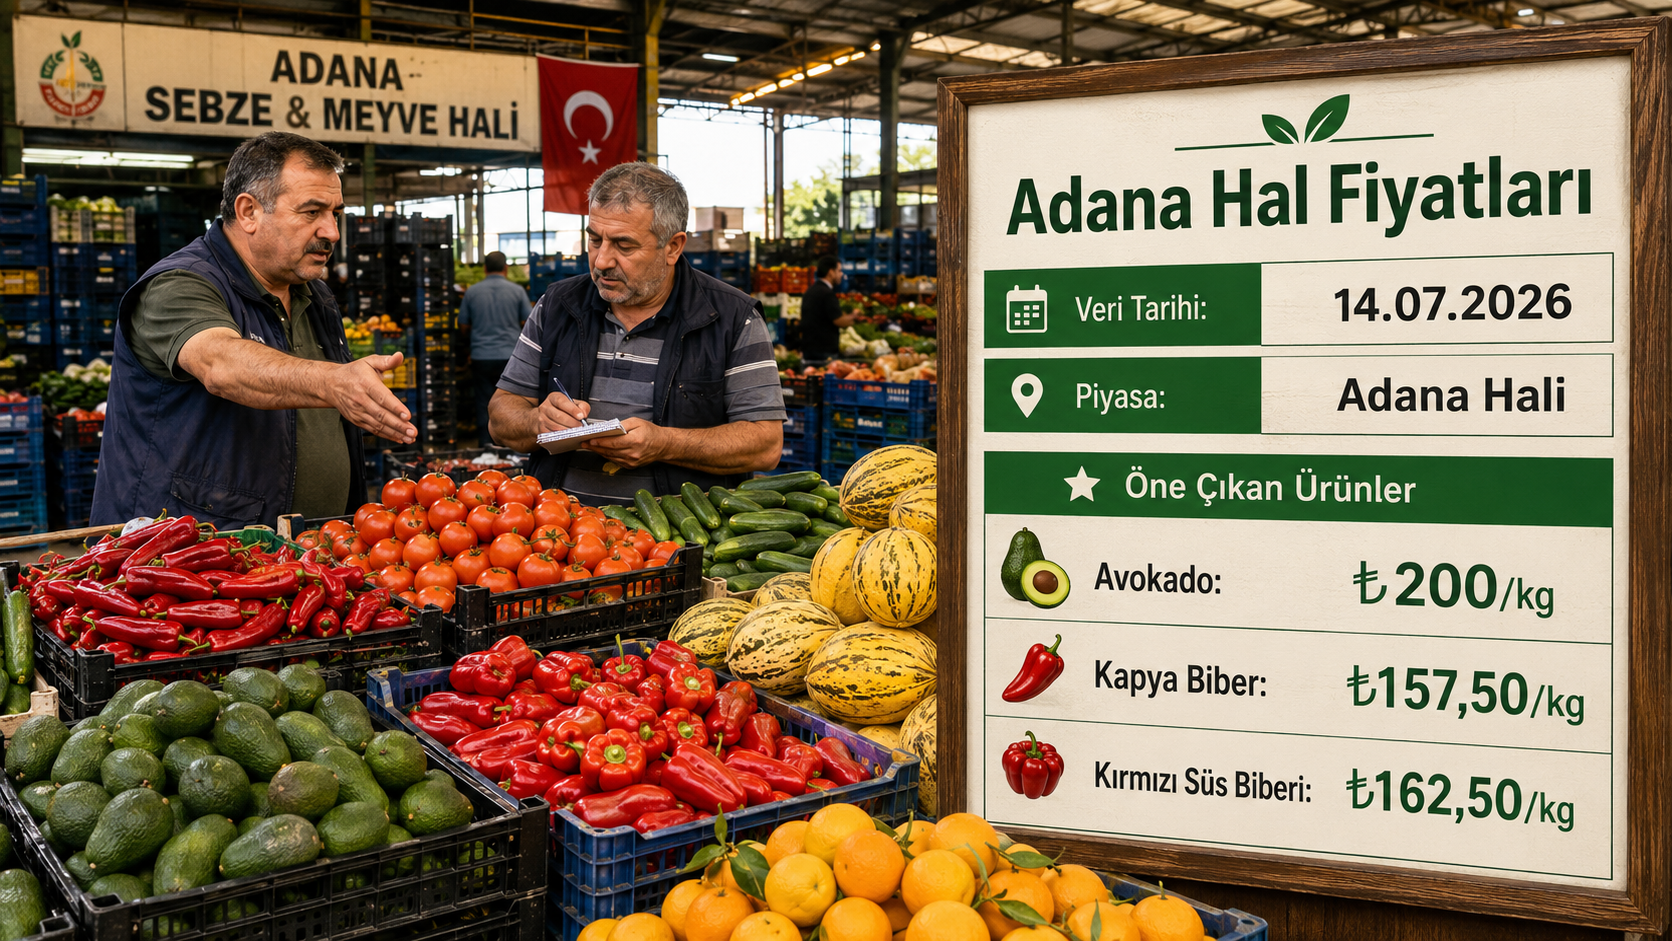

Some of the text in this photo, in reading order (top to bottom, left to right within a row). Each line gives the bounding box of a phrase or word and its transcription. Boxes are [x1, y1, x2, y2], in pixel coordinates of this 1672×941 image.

[271, 49, 404, 92] ADANA
[145, 85, 273, 127] SEBZE
[286, 95, 311, 129] &
[323, 97, 439, 136] MEYVE
[449, 101, 519, 141] HALİ
[1006, 155, 1593, 239] Adana Hal Fiyatları
[1074, 293, 1207, 322] Veri Tarihi:
[1334, 282, 1573, 323] 14.07.2026
[1076, 382, 1165, 416] Piyasa:
[1336, 376, 1566, 413] Adana Hali
[1125, 465, 1417, 507] Öne Çıkan Ürünler
[1094, 561, 1222, 595] Avokado:
[1095, 659, 1267, 699] Kapya Biber:
[1346, 664, 1585, 726] ₺157,50/kg
[1095, 760, 1312, 803] Kırmızı Süs Biberi:
[1345, 768, 1575, 833] ₺162,50/kg
